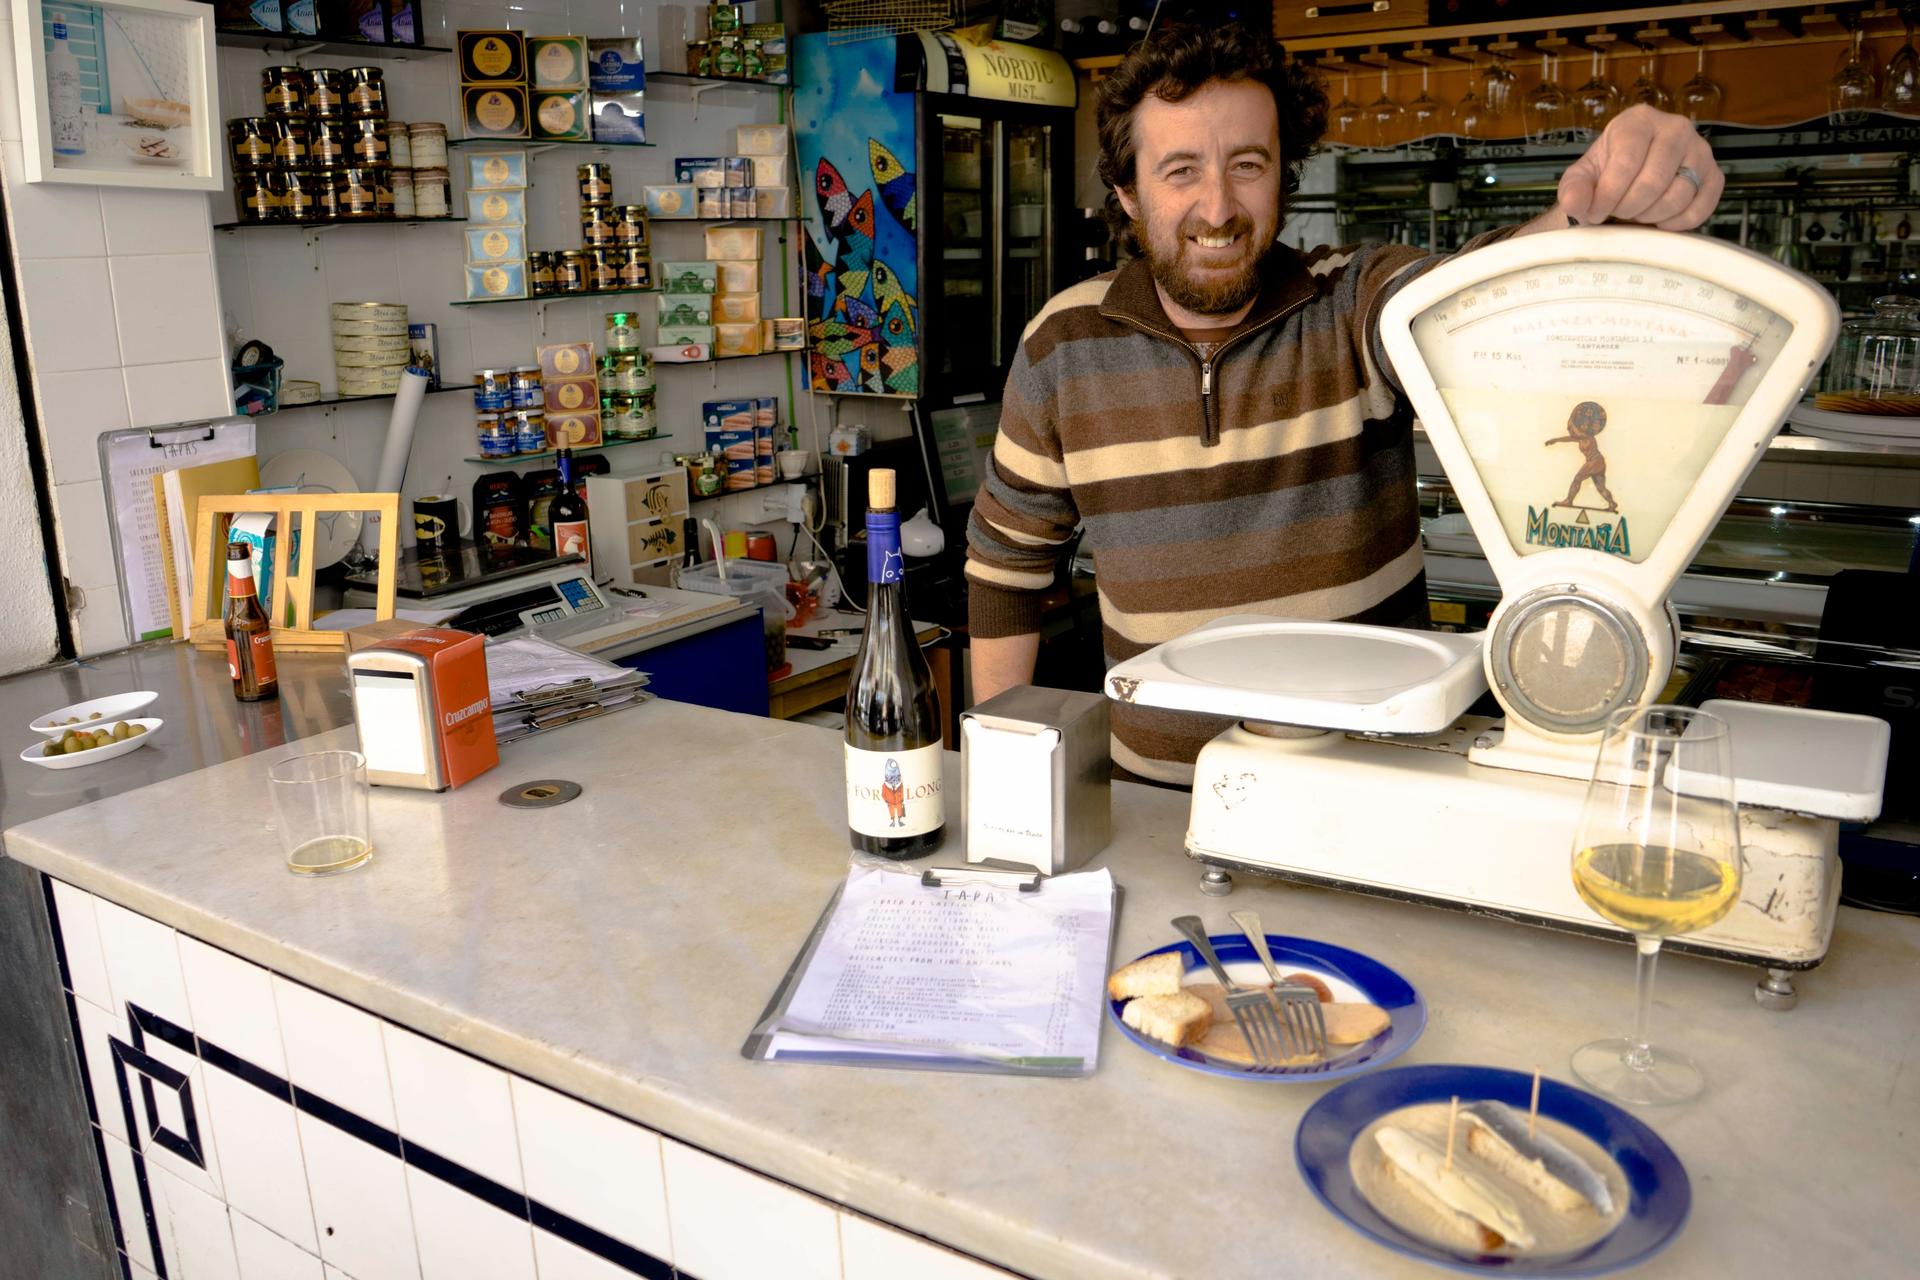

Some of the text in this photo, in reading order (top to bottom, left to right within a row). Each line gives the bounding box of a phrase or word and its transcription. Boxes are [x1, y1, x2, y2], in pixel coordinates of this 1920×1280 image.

[1008, 82, 1036, 99] MIST
[1558, 274, 1574, 285] 600
[1592, 272, 1608, 283] 500
[1628, 274, 1644, 285] 400
[163, 441, 198, 459] TAPAS
[1525, 504, 1632, 557] MONTAÑA
[445, 696, 489, 727] Cruzcampo
[854, 778, 944, 802] FOR LONG
